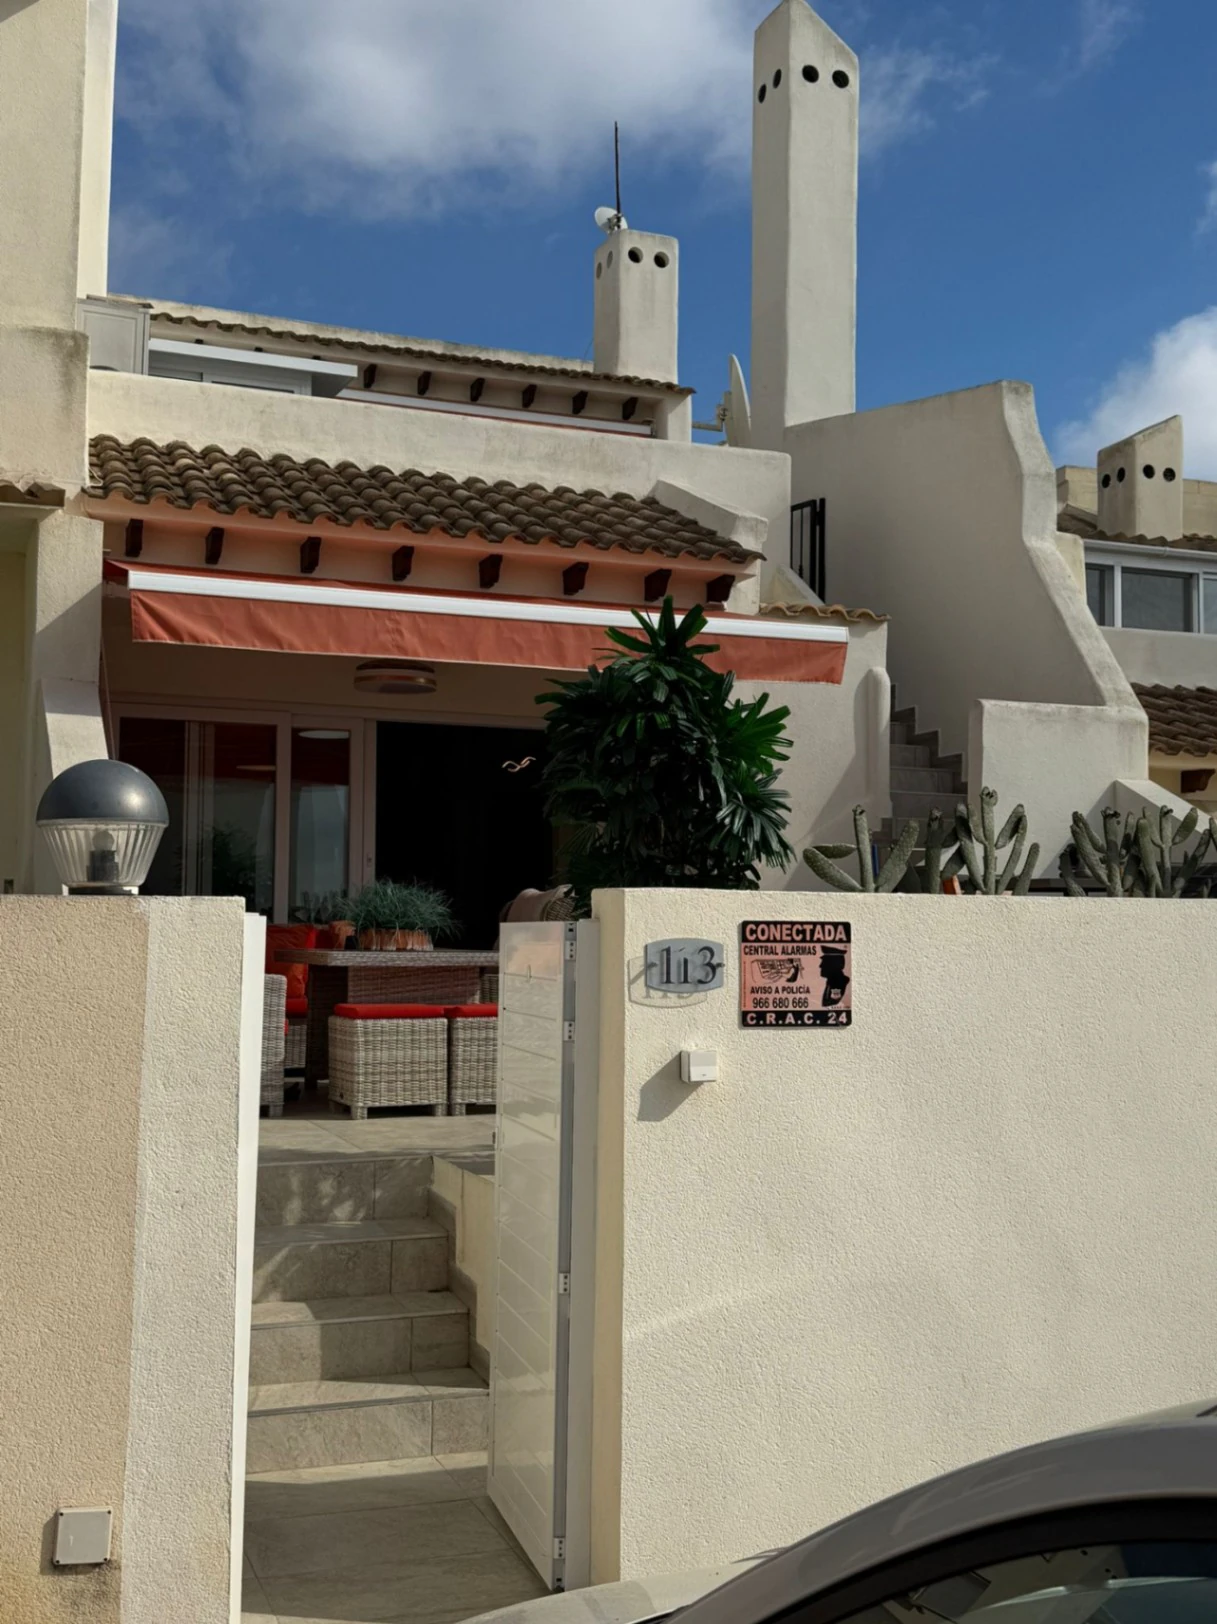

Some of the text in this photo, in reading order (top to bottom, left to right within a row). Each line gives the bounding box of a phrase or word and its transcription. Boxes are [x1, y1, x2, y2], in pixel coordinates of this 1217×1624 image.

[745, 923, 847, 941] CONECTADA
[743, 945, 817, 956] CENTRAL ALARMAS
[750, 986, 773, 995] AVISO
[774, 986, 780, 995] A
[752, 997, 809, 1009] 966 680 666
[746, 1012, 848, 1025] C.R.A.C. 24
